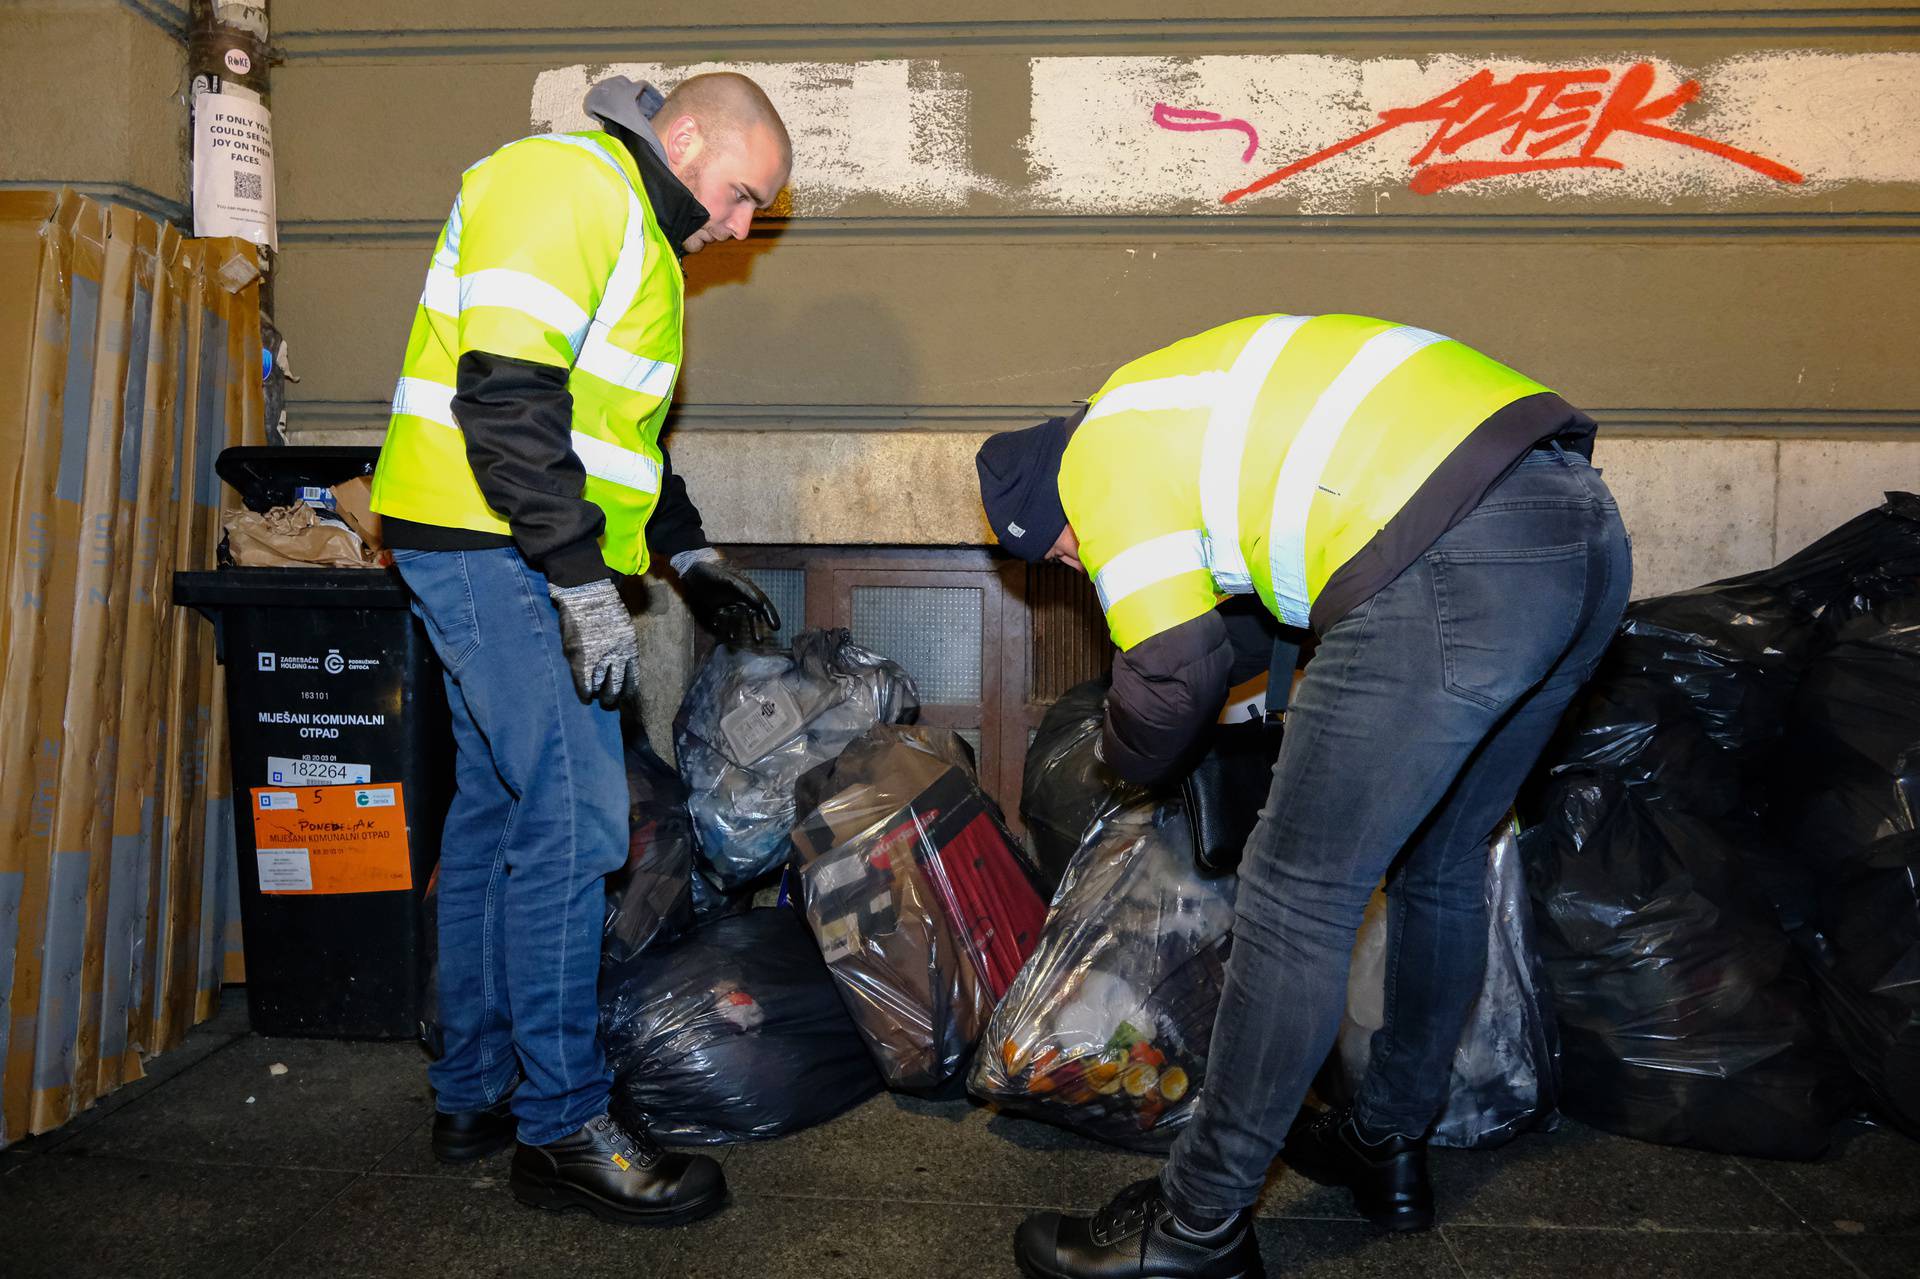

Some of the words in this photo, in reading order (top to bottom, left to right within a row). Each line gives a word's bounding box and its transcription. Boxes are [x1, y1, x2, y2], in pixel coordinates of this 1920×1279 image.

[215, 113, 224, 121] IF
[226, 115, 253, 127] ONLY
[255, 121, 270, 134] YOU
[210, 125, 244, 137] COULD
[246, 131, 260, 142] SEE
[212, 138, 231, 147] JOY
[233, 141, 249, 151] ON
[231, 153, 262, 166] FACES.
[301, 691, 329, 700] 163101
[258, 711, 310, 725] MIJEŠANI
[312, 713, 385, 725] KOMUNALNI
[299, 727, 340, 739] OTPAD
[291, 762, 347, 779] 182264
[312, 789, 323, 804] 5
[308, 832, 360, 842] KOMUNALNI
[361, 830, 390, 840] OTPAD
